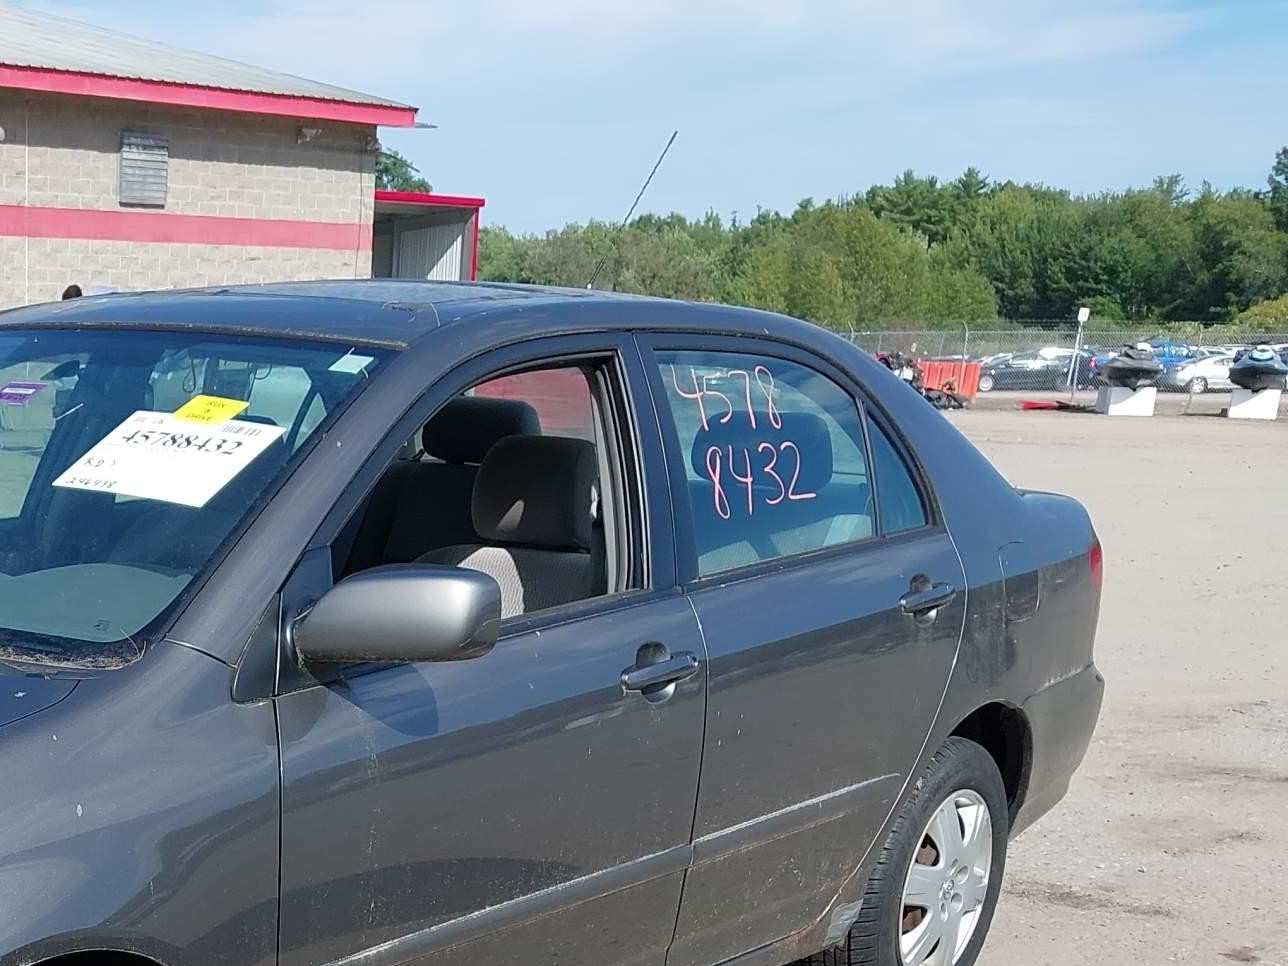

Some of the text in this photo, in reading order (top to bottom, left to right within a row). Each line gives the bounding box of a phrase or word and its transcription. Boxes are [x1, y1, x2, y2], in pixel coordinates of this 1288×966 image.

[670, 364, 783, 432] 4578
[121, 430, 244, 456] 45788432
[705, 441, 817, 519] 8432
